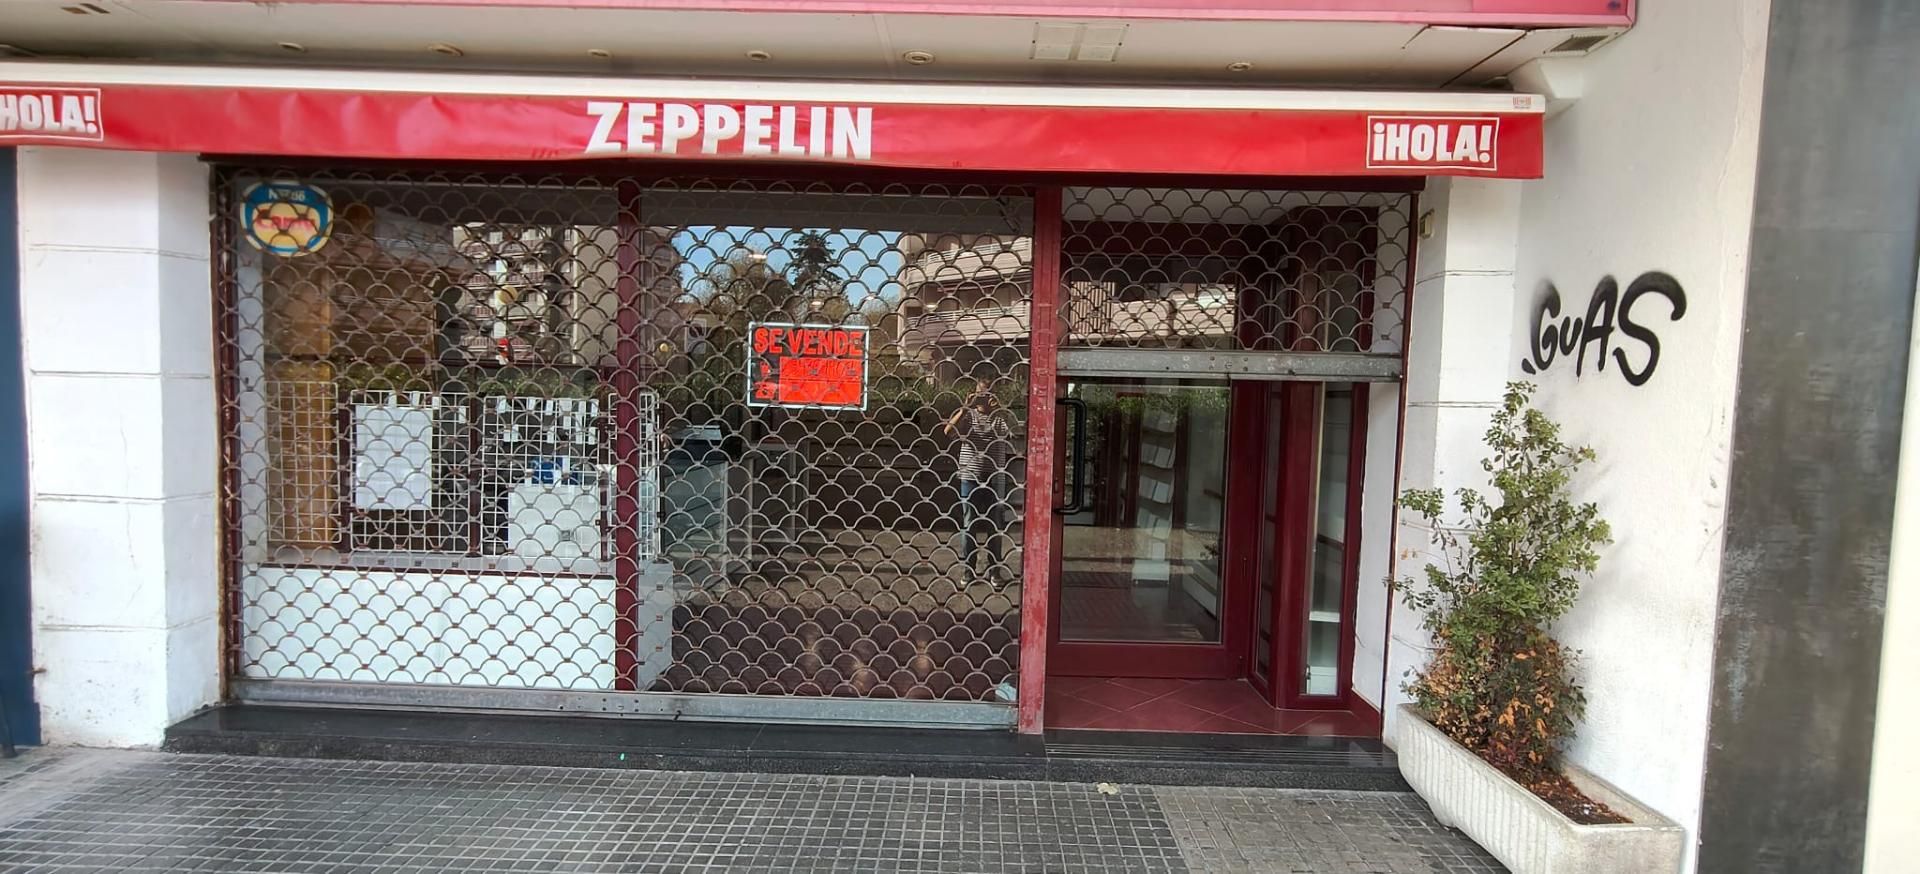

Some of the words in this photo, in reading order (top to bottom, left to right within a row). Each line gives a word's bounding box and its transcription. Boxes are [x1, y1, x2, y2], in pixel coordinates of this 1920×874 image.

[584, 101, 873, 160] ZEPPELIN
[1372, 122, 1493, 164] ¡HOLA!
[754, 326, 783, 354] SE
[787, 329, 864, 356] VENDE
